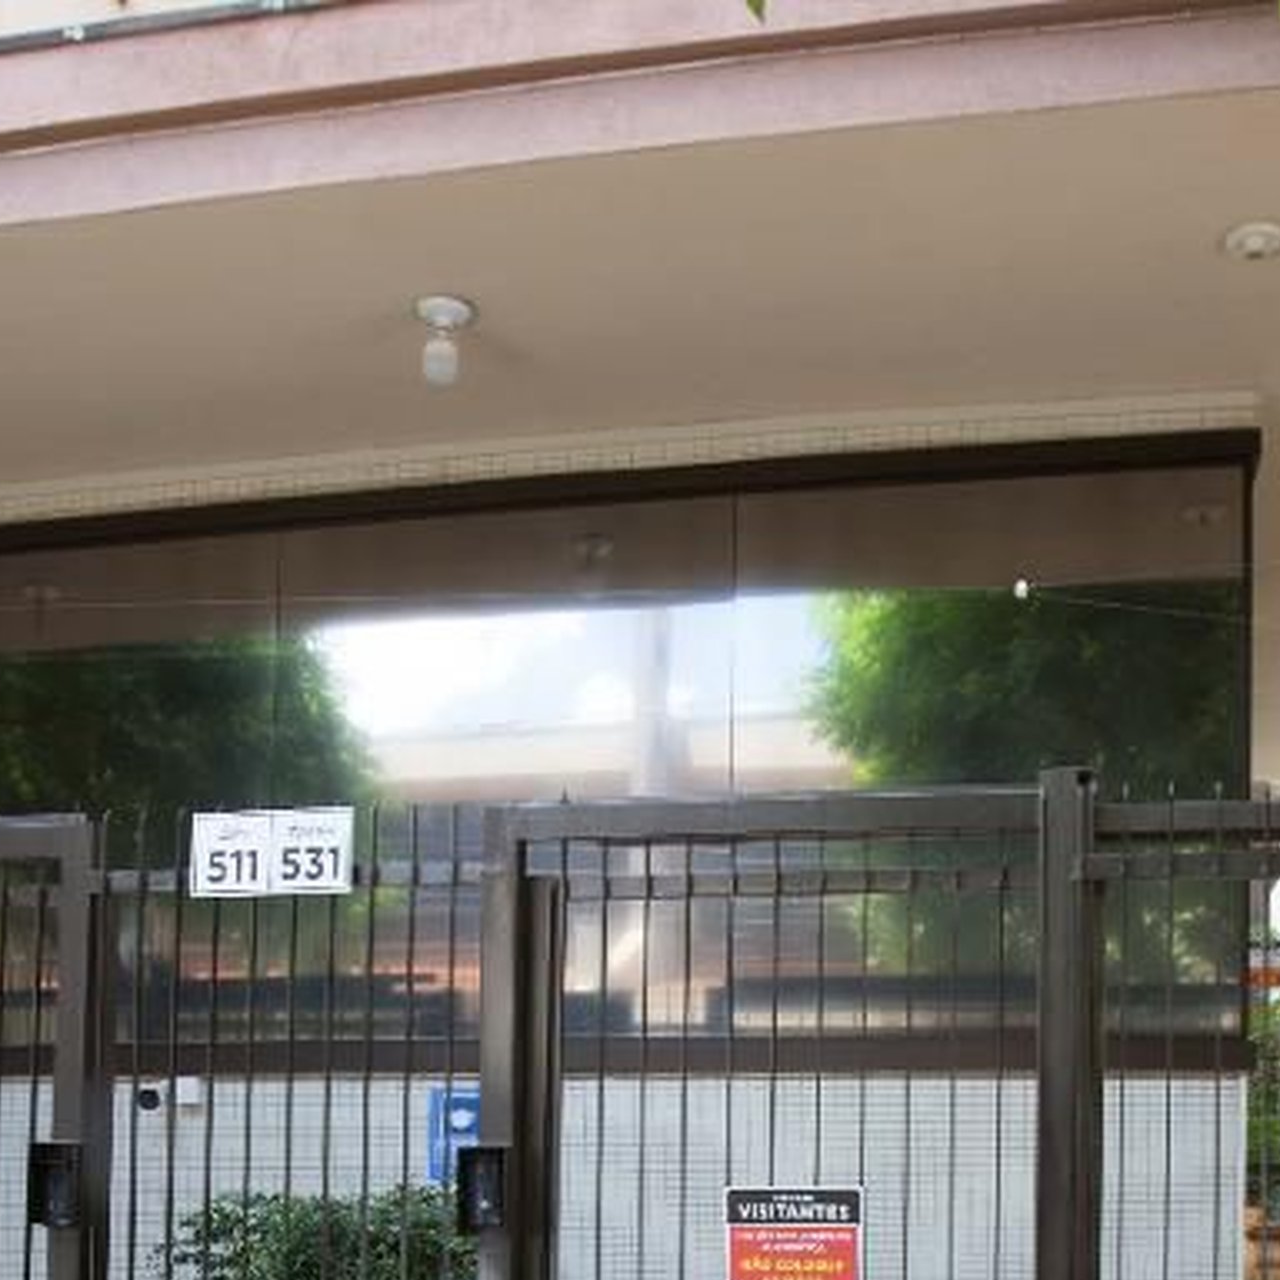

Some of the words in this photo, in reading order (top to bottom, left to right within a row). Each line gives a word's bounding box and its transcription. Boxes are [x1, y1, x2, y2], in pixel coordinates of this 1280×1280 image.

[206, 849, 259, 883] 511
[282, 846, 340, 881] 531
[738, 1203, 851, 1220] VISITANTES
